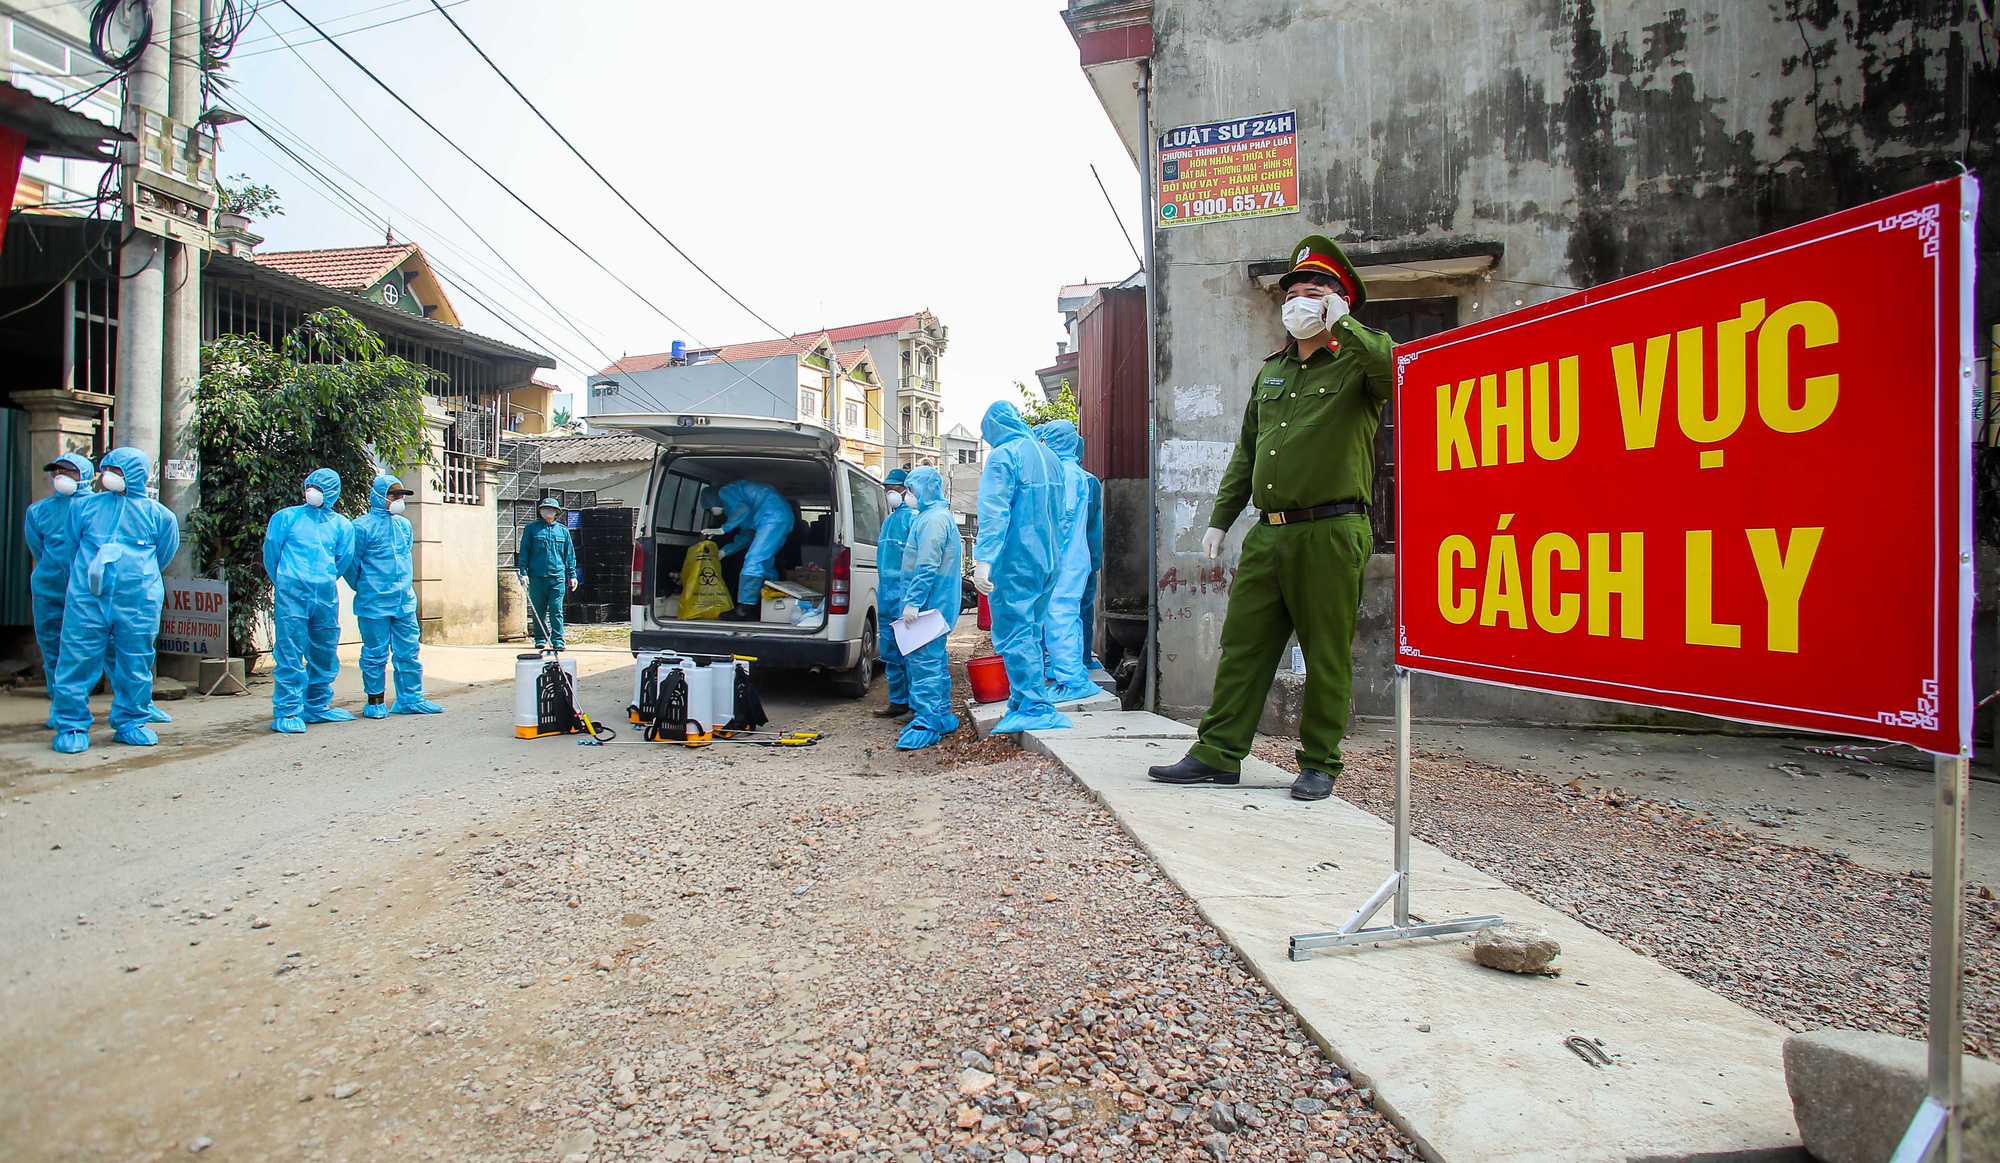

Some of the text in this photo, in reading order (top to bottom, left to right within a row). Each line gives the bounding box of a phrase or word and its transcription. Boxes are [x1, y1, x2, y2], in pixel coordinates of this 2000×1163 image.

[1163, 116, 1292, 148] LUẬT SƯ 24H
[1162, 136, 1293, 161] CHƯƠNG TRÌNH TƯ VẤN PHÁP LUẬT
[1190, 157, 1207, 168] HÔN
[1209, 154, 1234, 166] NHÂN
[1241, 150, 1264, 162] THỪA
[1265, 147, 1277, 159] KẾ
[1180, 168, 1194, 180] ĐẤT
[1213, 165, 1241, 176] THƯƠNG
[1242, 163, 1257, 173] MẠI
[1263, 159, 1281, 170] HÌNH
[1282, 157, 1293, 168] SỰ
[1162, 181, 1180, 193] ĐÒI
[1182, 180, 1197, 191] NỢ
[1199, 178, 1219, 188] VAY
[1229, 174, 1258, 185] HÀNH
[1260, 168, 1294, 181] CHÍNH
[1175, 190, 1196, 203] ĐẦU
[1198, 189, 1212, 200] TƯ
[1220, 185, 1249, 197] NGÂN
[1252, 182, 1281, 194] HÀNG
[1182, 190, 1285, 218] 1900.65.74
[1436, 298, 1839, 472] KHU VỰC
[1437, 513, 1825, 653] CÁCH LY
[173, 590, 191, 610] XE
[1165, 606, 1192, 620] 4.45
[198, 622, 222, 640] THOẠI
[193, 639, 208, 654] LÁ
